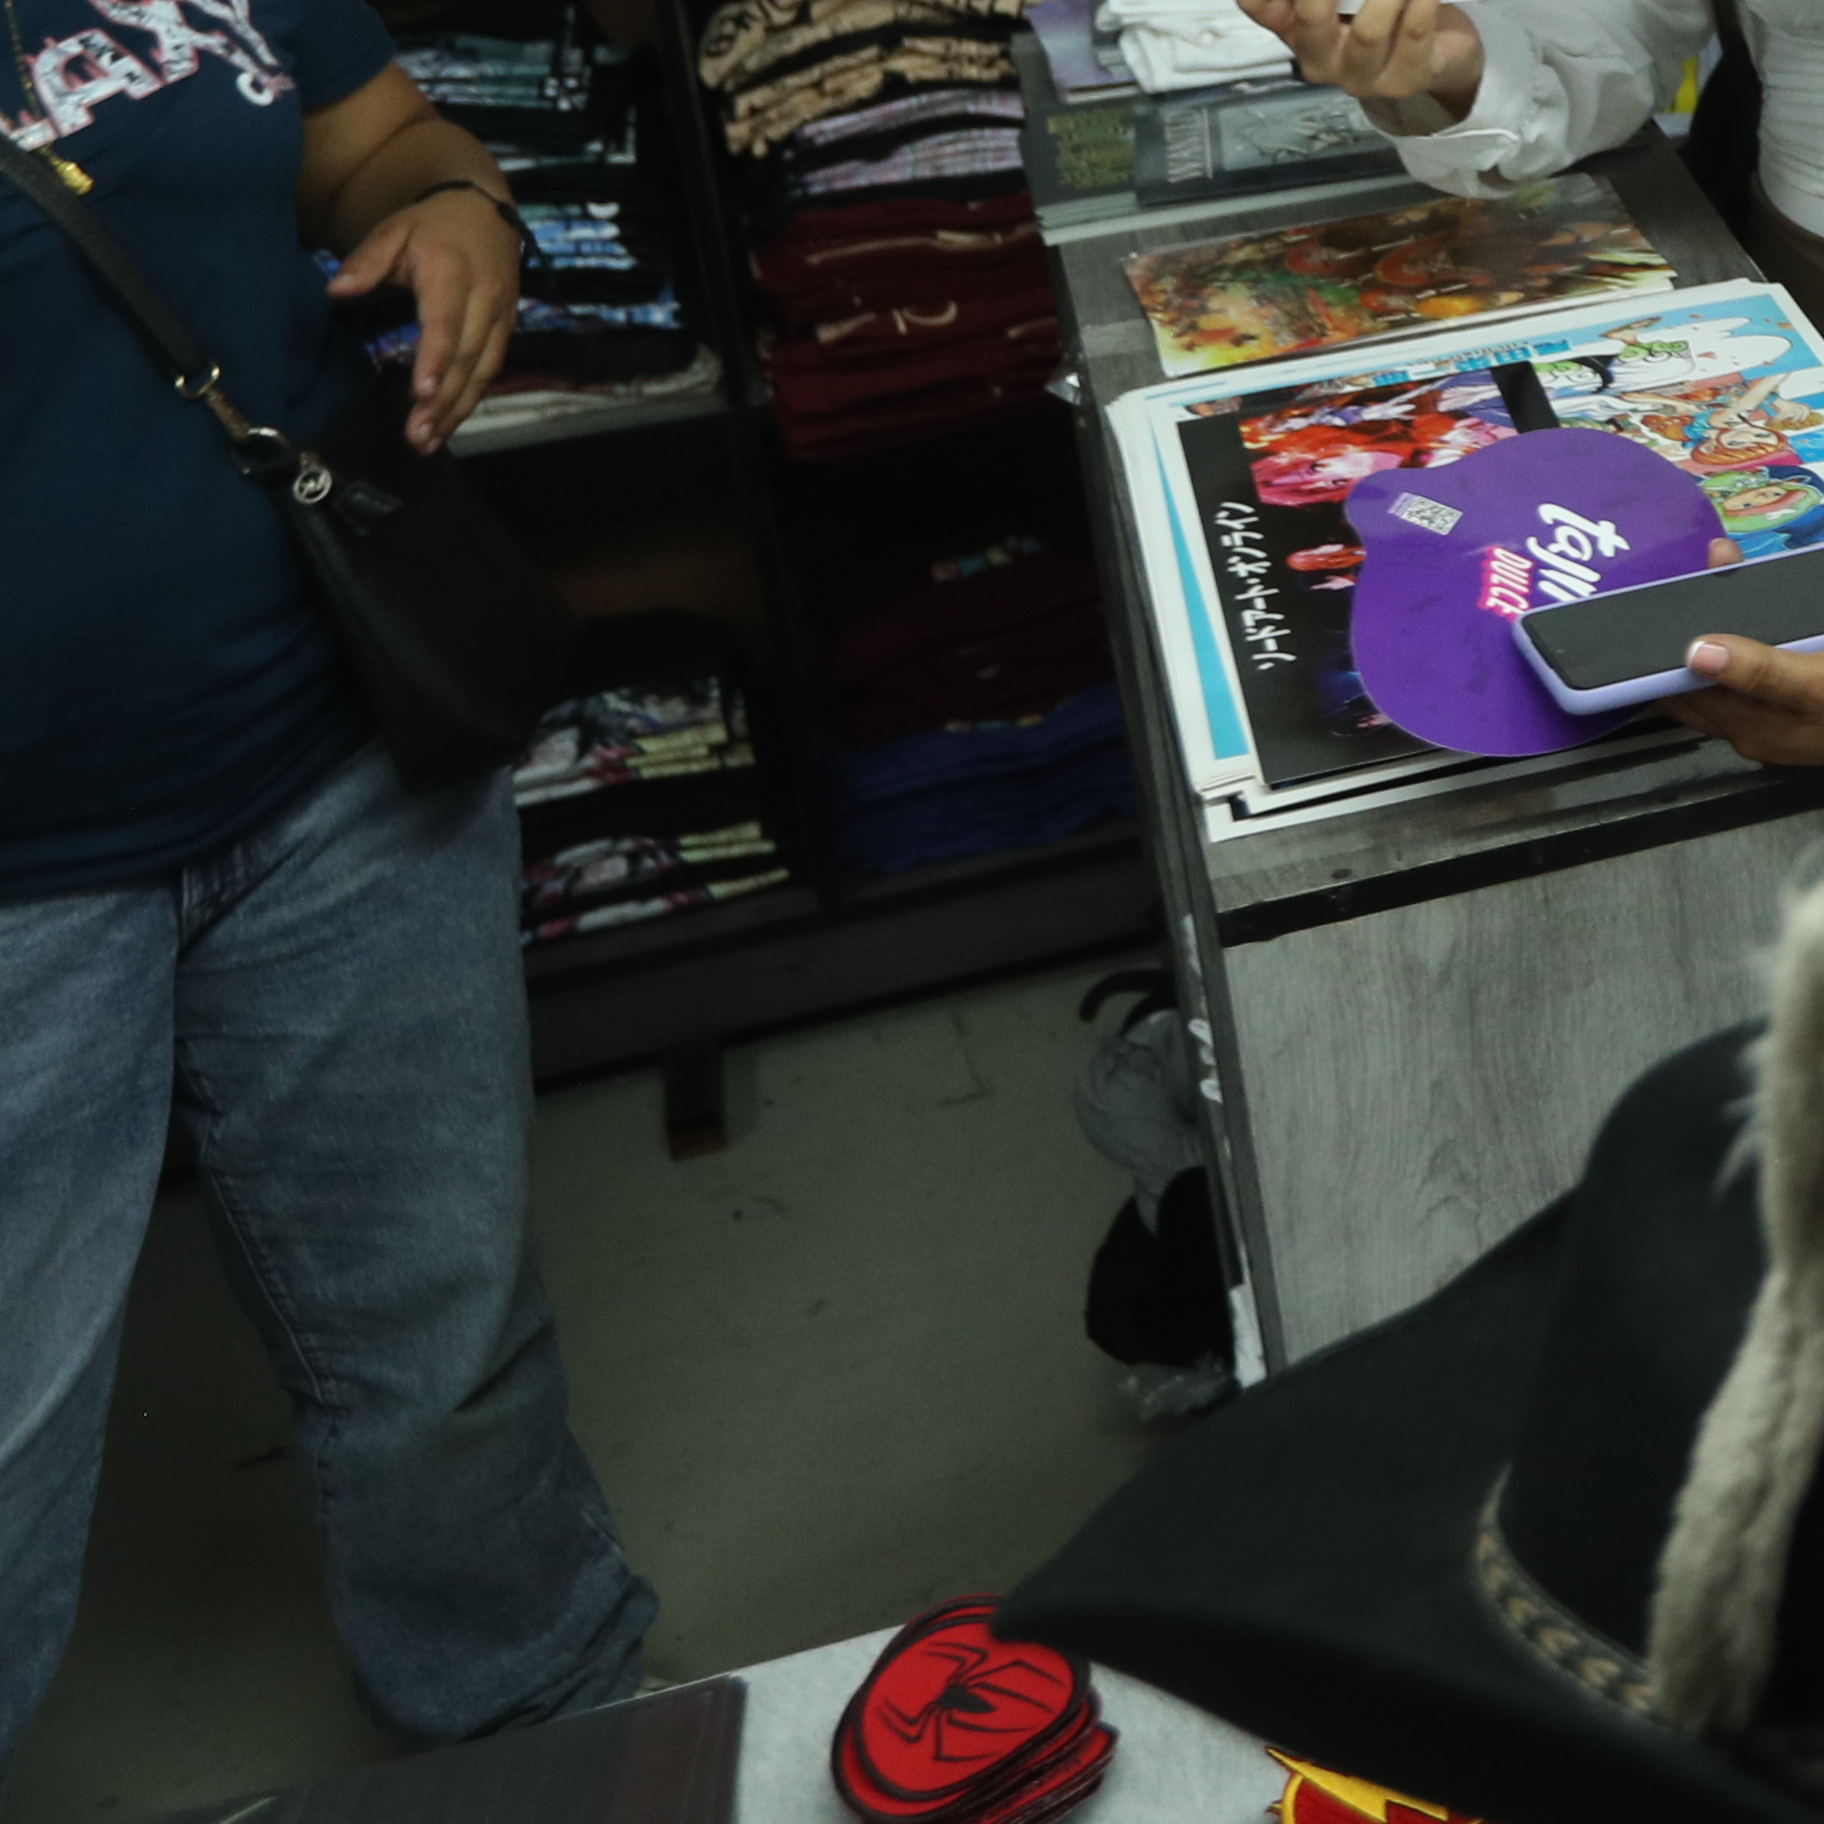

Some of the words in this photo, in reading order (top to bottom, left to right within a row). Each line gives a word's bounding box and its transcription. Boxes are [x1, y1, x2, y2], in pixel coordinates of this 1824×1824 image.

[1214, 501, 1297, 670] ソードアート・オンライン
